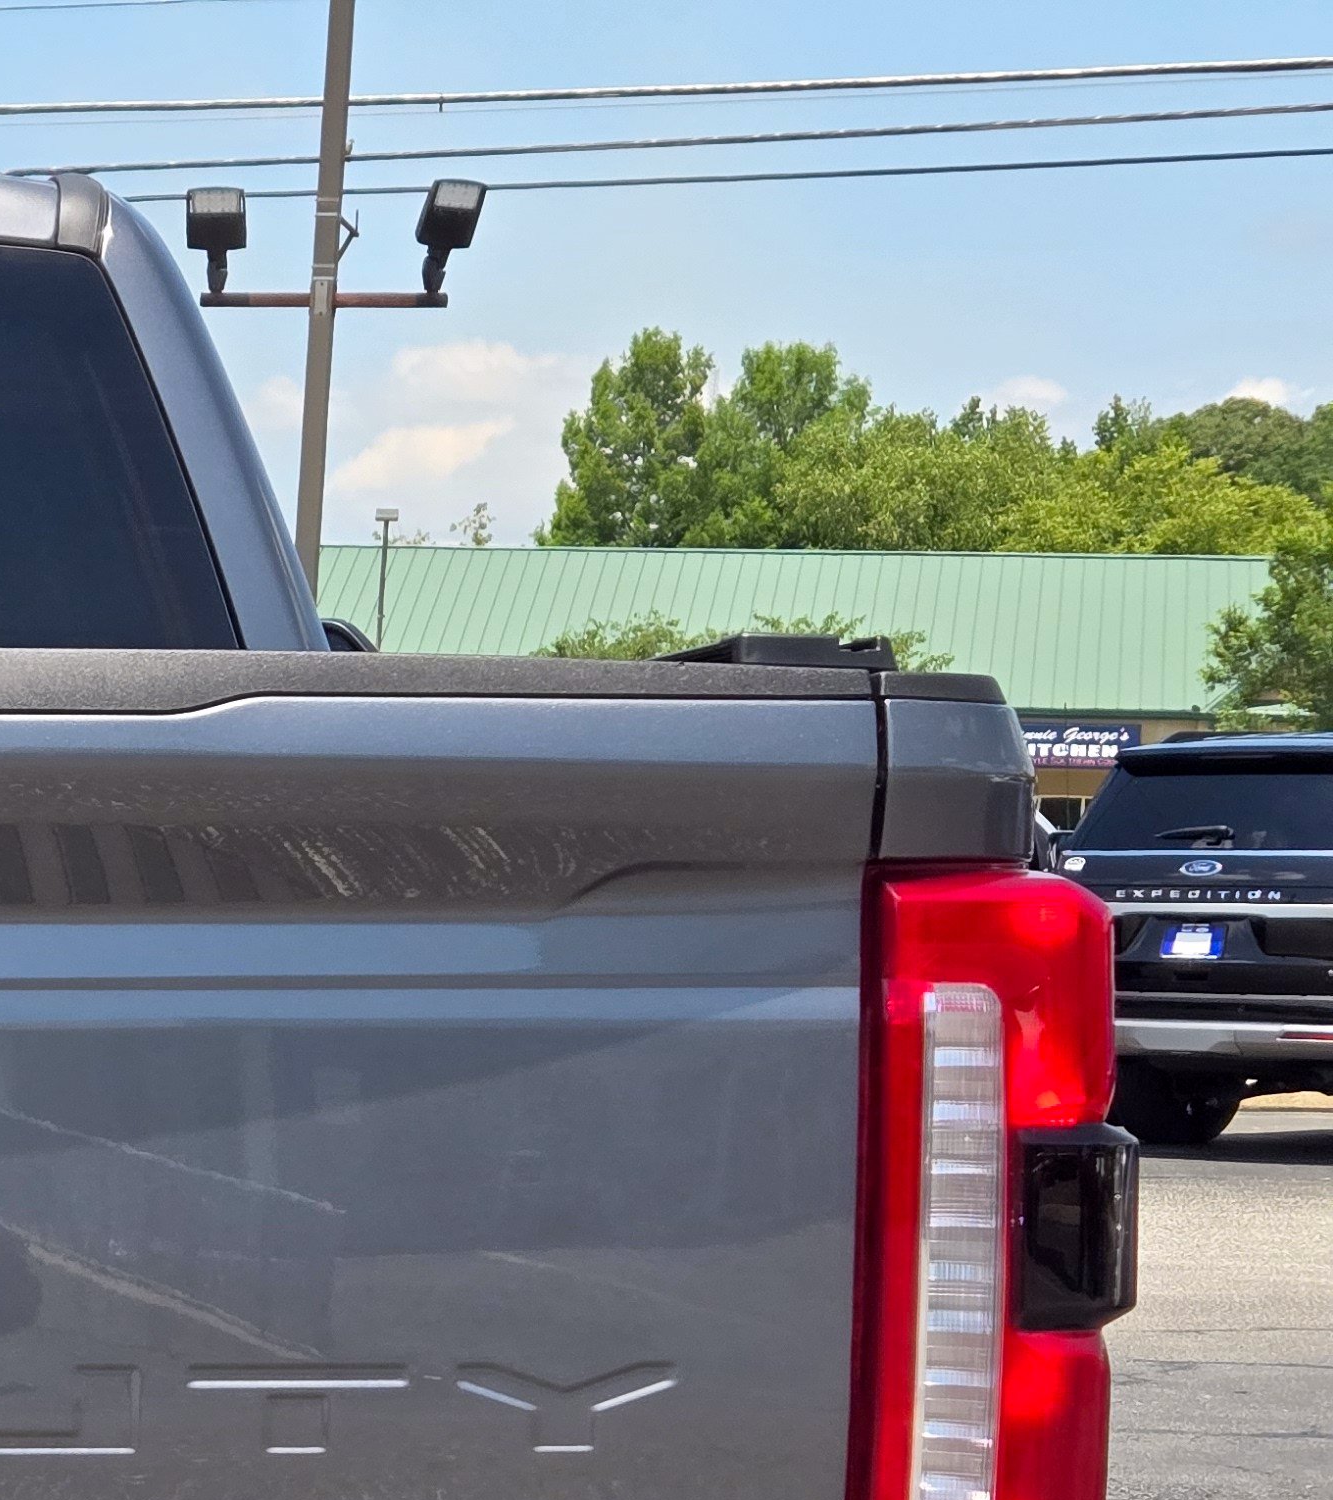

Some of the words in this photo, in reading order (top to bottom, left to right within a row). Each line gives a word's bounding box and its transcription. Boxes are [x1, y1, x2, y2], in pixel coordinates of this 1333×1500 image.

[1063, 727, 1130, 744] George's
[1027, 743, 1119, 758] ITCHEN
[1115, 889, 1282, 900] EXPEDITION
